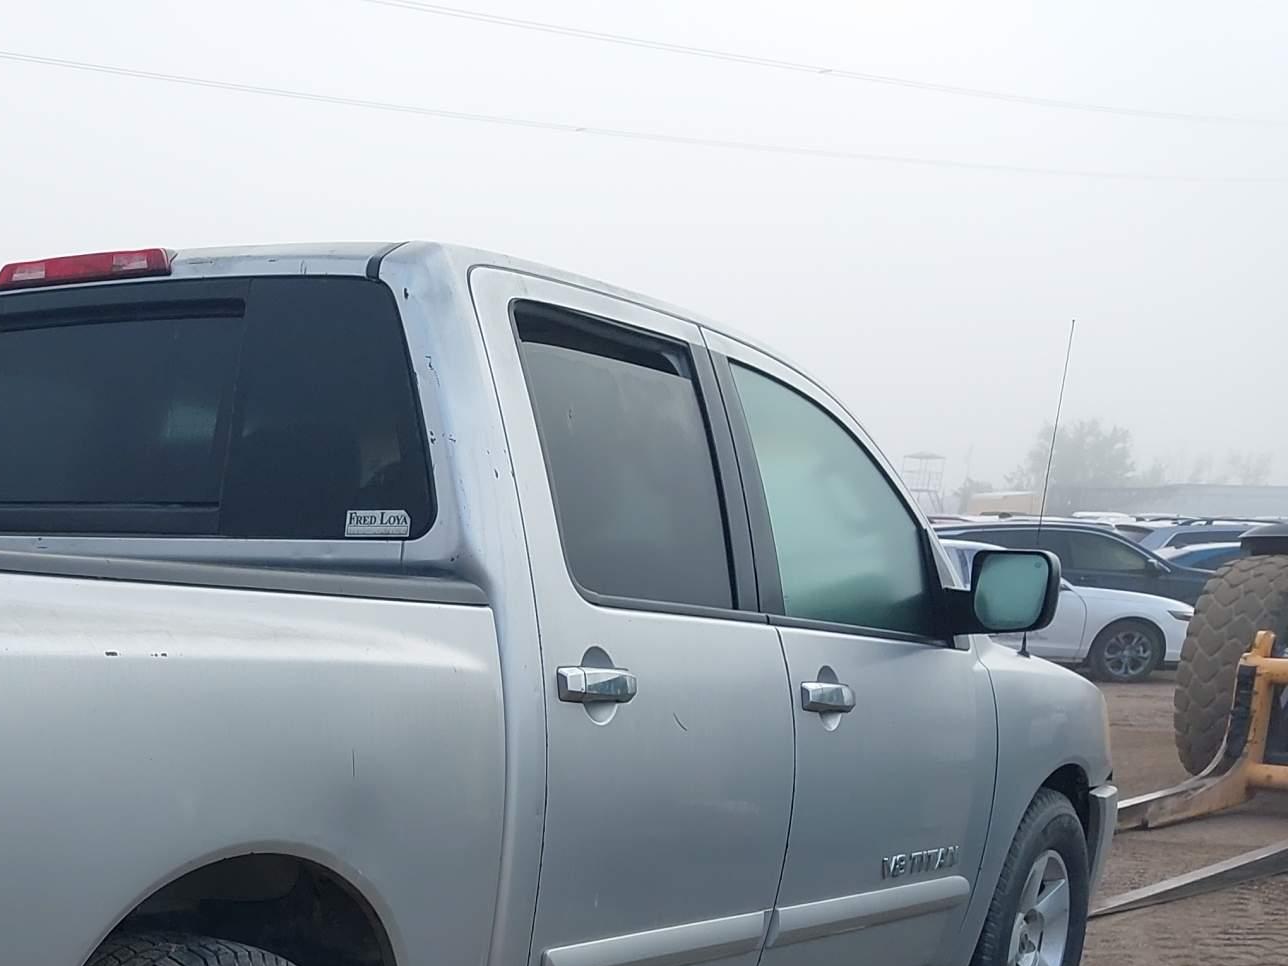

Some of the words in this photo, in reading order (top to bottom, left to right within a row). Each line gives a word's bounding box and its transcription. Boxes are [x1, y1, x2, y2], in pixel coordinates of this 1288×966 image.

[349, 511, 377, 525] FRED
[379, 511, 408, 525] LOYA
[909, 845, 960, 875] TITAN
